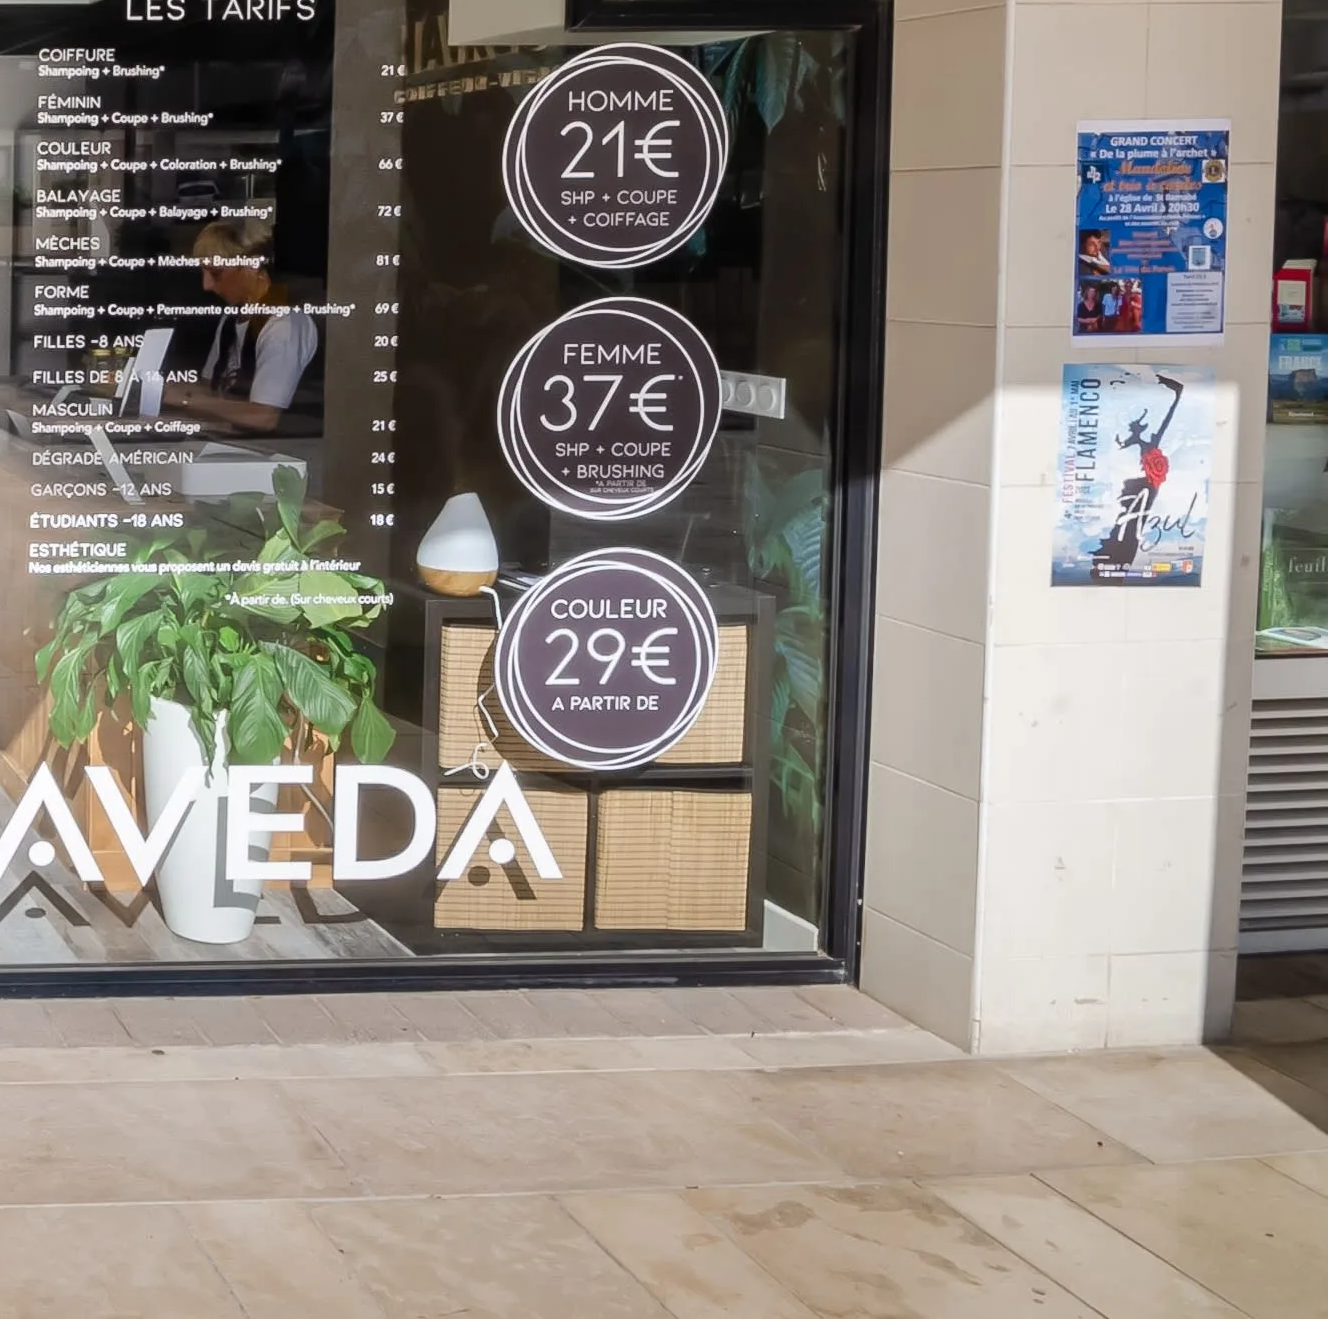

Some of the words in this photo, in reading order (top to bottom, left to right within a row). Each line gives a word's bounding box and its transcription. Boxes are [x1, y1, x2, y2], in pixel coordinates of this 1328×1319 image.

[39, 49, 115, 62] COIFFURE
[38, 65, 100, 78] Shampoing
[381, 65, 395, 76] 21
[38, 95, 101, 109] FÉMININ
[568, 90, 674, 111] HOMME
[37, 112, 98, 126] Shampoing
[111, 112, 147, 126] Coupe
[380, 112, 394, 123] 37
[1110, 136, 1148, 146] GRAND
[1150, 135, 1198, 146] CONCERT
[37, 142, 111, 155] COULEUR
[560, 120, 680, 178] 21€
[1099, 150, 1113, 159] De
[1116, 150, 1124, 158] la
[1127, 149, 1158, 160] plume
[37, 159, 97, 173] Shampoing
[111, 159, 147, 173] Coupe
[160, 159, 216, 170] Coloration
[379, 159, 392, 170] 66
[37, 190, 120, 202] BALAYAGE
[561, 191, 595, 205] SHP
[617, 190, 677, 204] COUPE
[36, 206, 97, 220] Shampoing
[110, 206, 146, 220] Coupe
[159, 206, 207, 220] Balayage
[377, 206, 391, 216] 72
[1106, 204, 1117, 213] Le
[1119, 204, 1132, 213] 28
[1133, 203, 1158, 212] Avril
[1168, 202, 1200, 212] 20h30
[583, 212, 670, 227] COIFFAGE
[36, 236, 100, 250] MÈCHES
[35, 256, 96, 269] Shampoing
[109, 256, 145, 269] Coupe
[158, 256, 200, 266] Mèches
[376, 255, 389, 266] 81
[35, 285, 89, 298] FORME
[34, 304, 95, 317] Shampoing
[108, 304, 143, 317] Coupe
[157, 304, 221, 315] Permanente
[375, 303, 389, 314] 69
[34, 335, 85, 348] FILLES
[113, 335, 143, 348] ANS
[375, 336, 388, 347] 20
[563, 344, 662, 365] FEMME
[33, 370, 84, 383] FILLES
[90, 370, 108, 383] DE
[115, 370, 123, 383] 8
[166, 370, 197, 383] ANS
[374, 371, 387, 382] 25
[32, 403, 113, 416] MASCULIN
[32, 421, 92, 435] Shampoing
[106, 421, 141, 435] Coupe
[155, 421, 200, 435] Coiffage
[372, 420, 385, 431] 21
[1075, 378, 1101, 481] FLAMENCO
[555, 443, 590, 457] SHP
[611, 442, 671, 456] COUPE
[110, 451, 193, 465] AMÉRICAIN
[372, 453, 385, 464] 24
[577, 464, 664, 478] BRUSHING
[1062, 454, 1075, 504] FESTIVAL
[31, 483, 106, 499] GARÇONS
[140, 483, 171, 496] ANS
[372, 484, 384, 494] 15
[30, 511, 118, 528] ÉTUDIANTS
[151, 515, 183, 527] ANS
[370, 515, 383, 526] 18
[1116, 488, 1198, 551] Azul
[30, 541, 126, 559] ESTHÉTIQUE
[550, 599, 668, 619] COULEUR
[544, 627, 678, 685] 29€
[552, 697, 564, 710] A
[570, 696, 631, 710] PARTIR
[637, 696, 659, 710] DE
